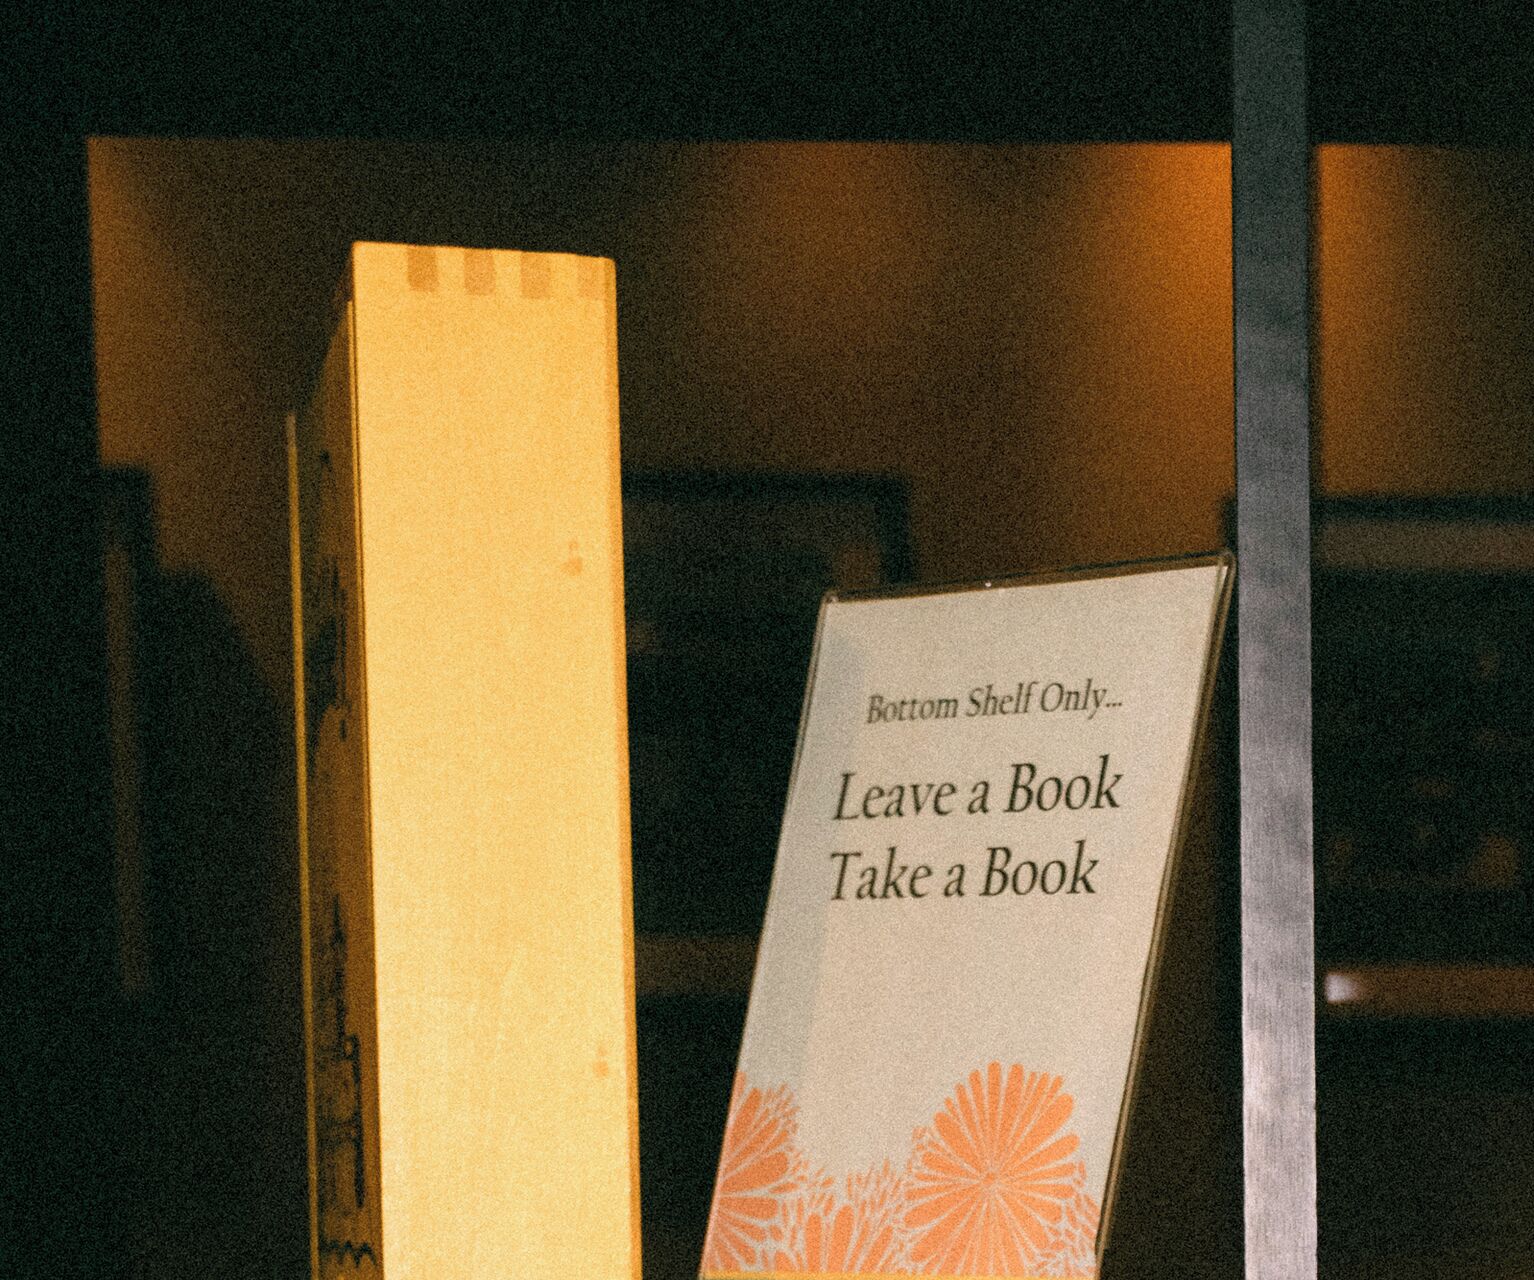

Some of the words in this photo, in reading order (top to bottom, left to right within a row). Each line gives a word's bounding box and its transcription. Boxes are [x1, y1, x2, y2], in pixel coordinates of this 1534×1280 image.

[866, 690, 960, 725] Bottom
[964, 682, 1040, 718] Shelf
[833, 771, 958, 820] Leave
[967, 780, 991, 814] a
[1003, 754, 1126, 815] Book
[830, 846, 933, 901] Take
[942, 863, 967, 898] a
[981, 839, 1102, 898] Book
